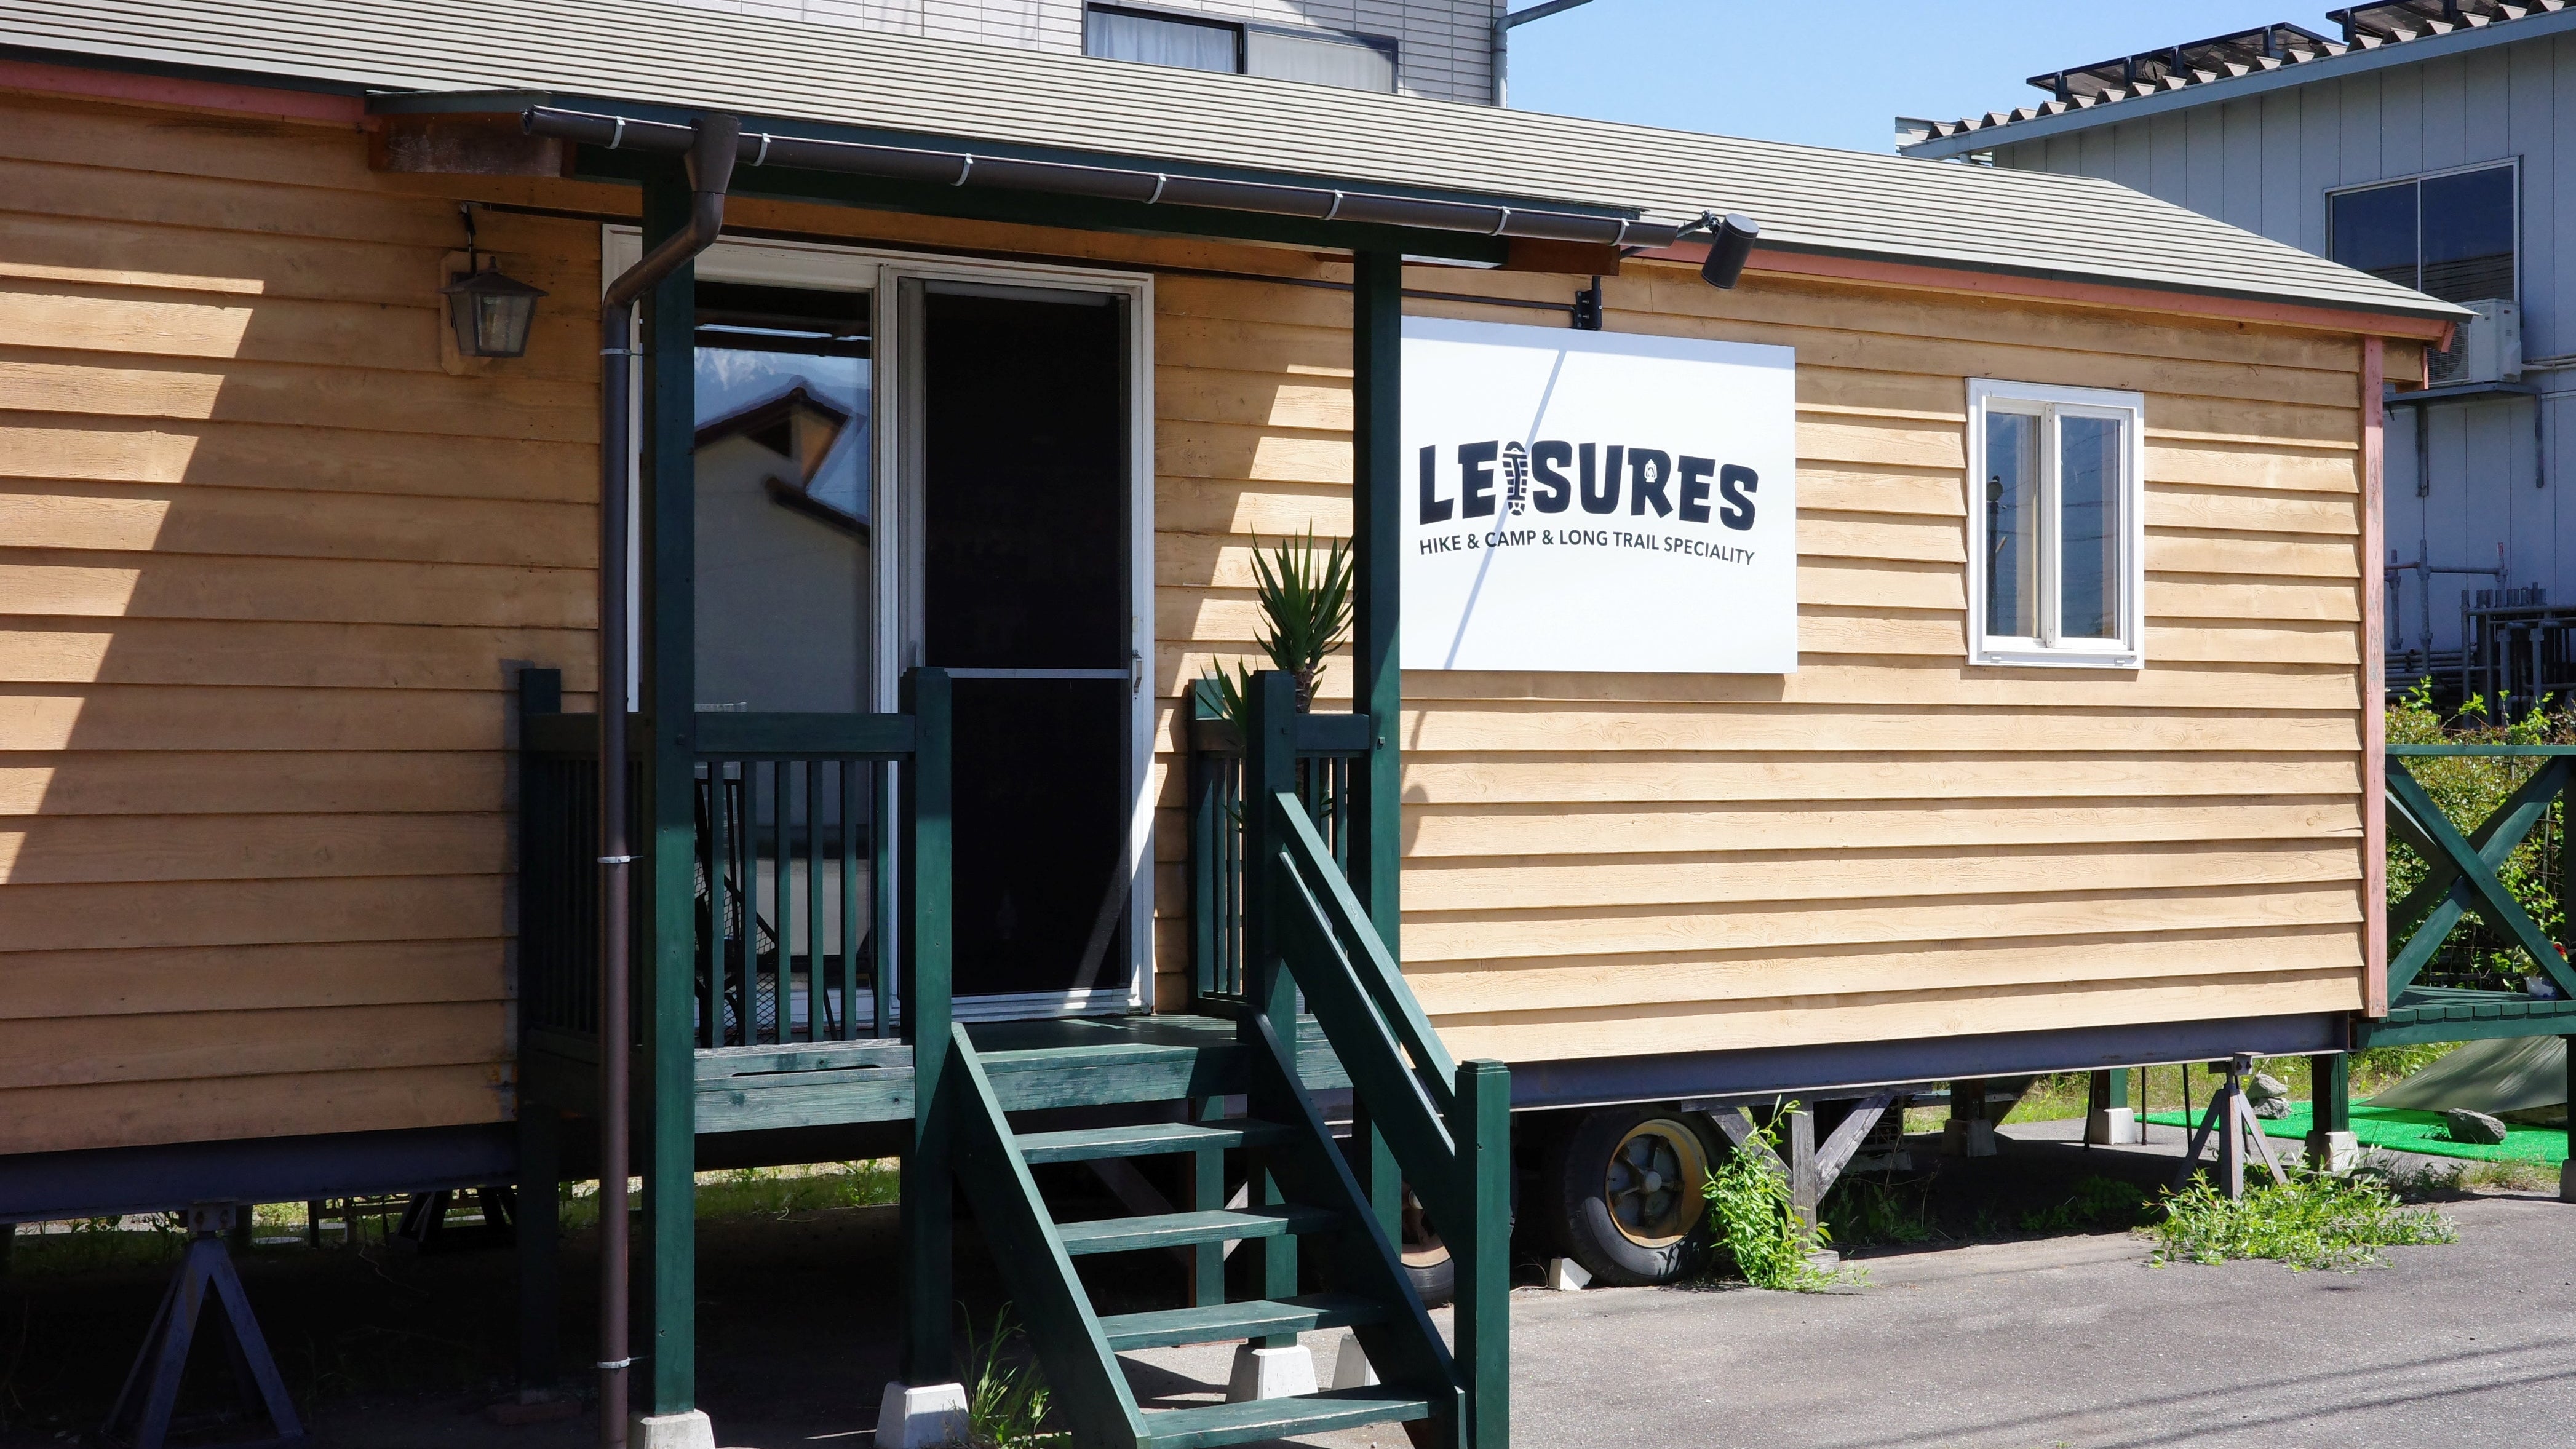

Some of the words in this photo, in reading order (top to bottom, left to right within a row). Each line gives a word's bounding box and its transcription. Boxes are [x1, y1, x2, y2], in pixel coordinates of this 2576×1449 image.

[1419, 440, 1759, 531] LEISURES
[1420, 535, 1461, 555] HIKE
[1468, 534, 1480, 549] &
[1485, 530, 1536, 548] CAMP
[1542, 530, 1554, 545] &
[1560, 530, 1607, 546] LONG
[1613, 532, 1660, 550] TRAIL
[1664, 537, 1755, 566] SPECIALITY
